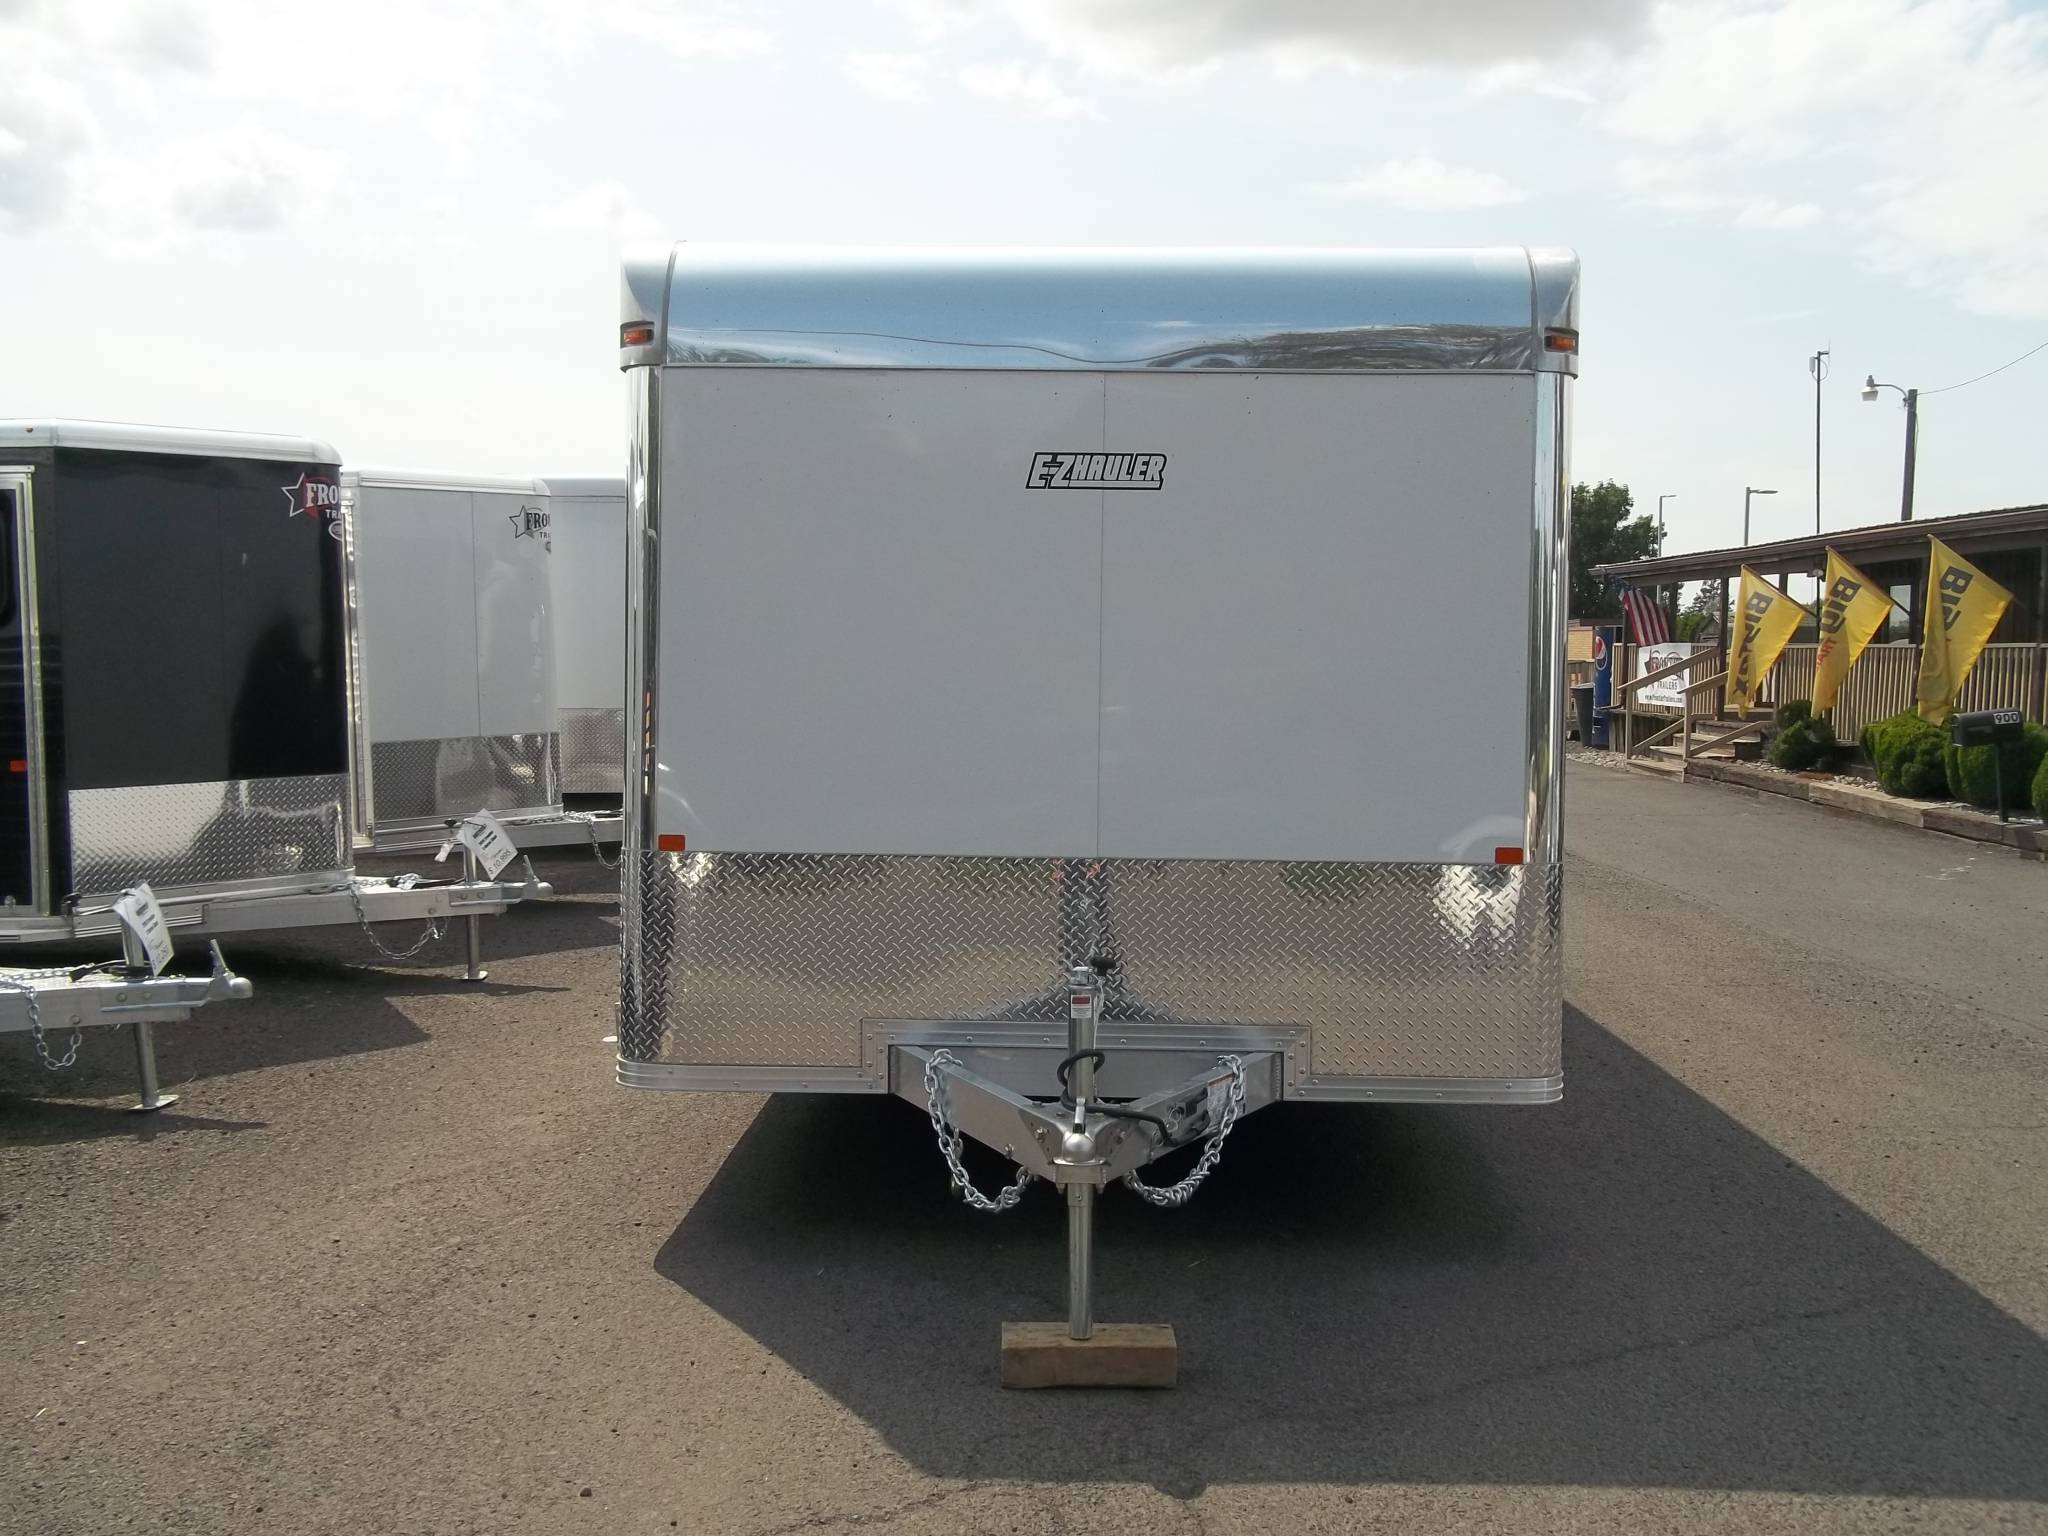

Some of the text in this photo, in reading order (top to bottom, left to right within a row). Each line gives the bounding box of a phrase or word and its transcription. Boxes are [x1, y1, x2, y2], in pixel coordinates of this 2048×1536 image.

[306, 483, 341, 507] FRO
[526, 512, 550, 530] FRO
[1995, 712, 2019, 724] 900
